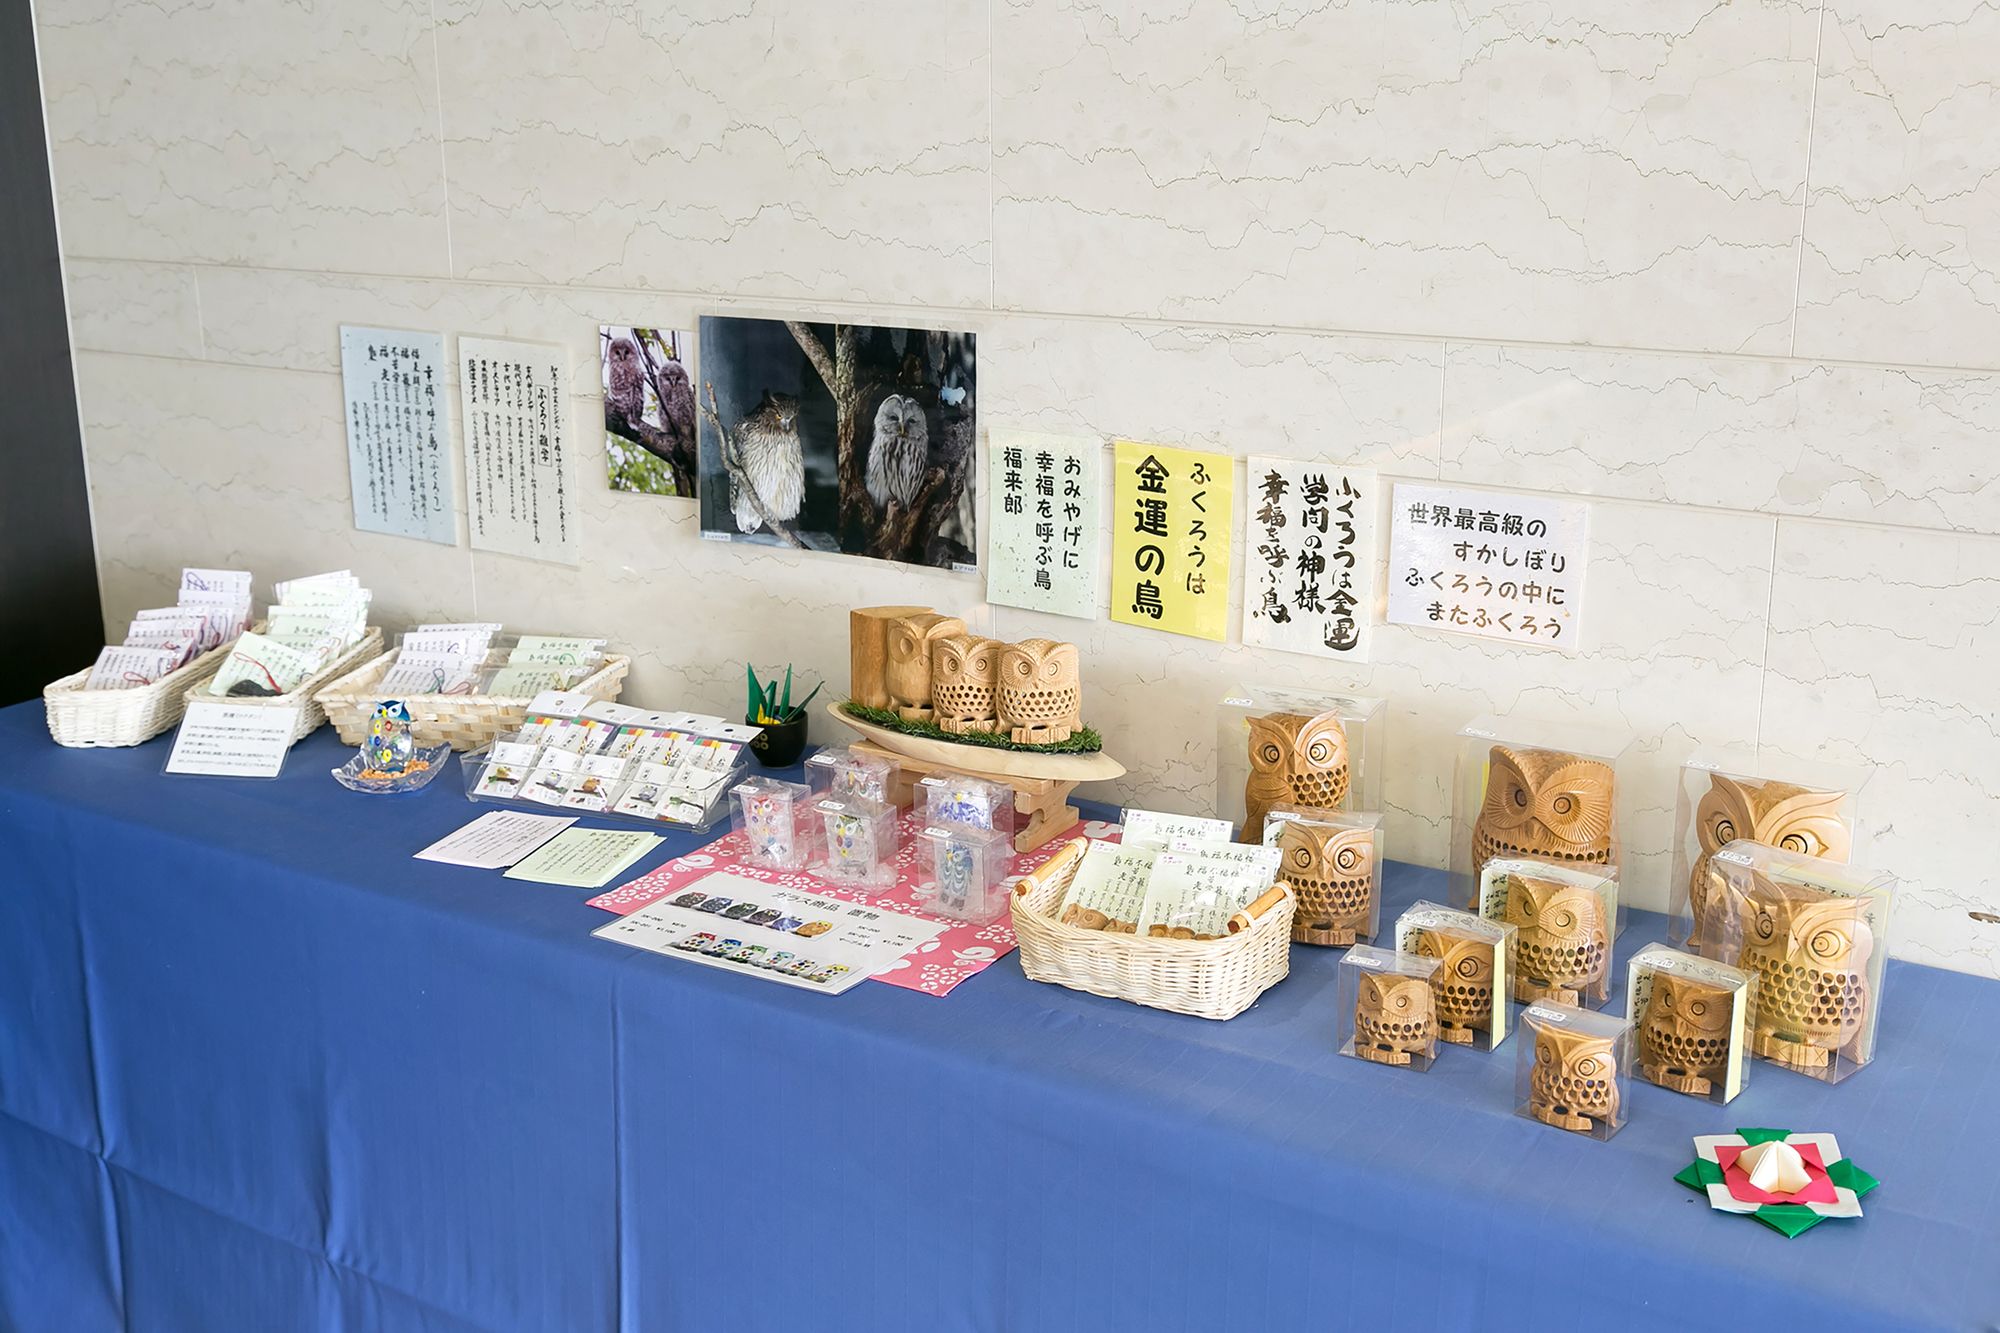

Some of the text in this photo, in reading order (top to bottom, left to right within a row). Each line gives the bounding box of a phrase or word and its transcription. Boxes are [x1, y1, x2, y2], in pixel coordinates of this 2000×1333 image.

[1003, 446, 1023, 515] 福来郎
[1034, 450, 1054, 590] 幸福を呼ぶ鳥
[1063, 456, 1082, 569] おみやげに
[1131, 454, 1170, 620] 金運の鳥
[1186, 463, 1211, 594] ふくろうは
[1408, 502, 1547, 538] 世界最高級の
[1253, 469, 1291, 624] 幸福を呼ぶ鳥
[1292, 473, 1329, 614] 学問の神様
[1324, 476, 1362, 651] ふくろうは金運
[1404, 567, 1565, 605] ふくろうの中に
[1453, 541, 1566, 573] すかしぼり
[1426, 601, 1562, 639] またふくろう
[772, 892, 840, 912] ガラス商品
